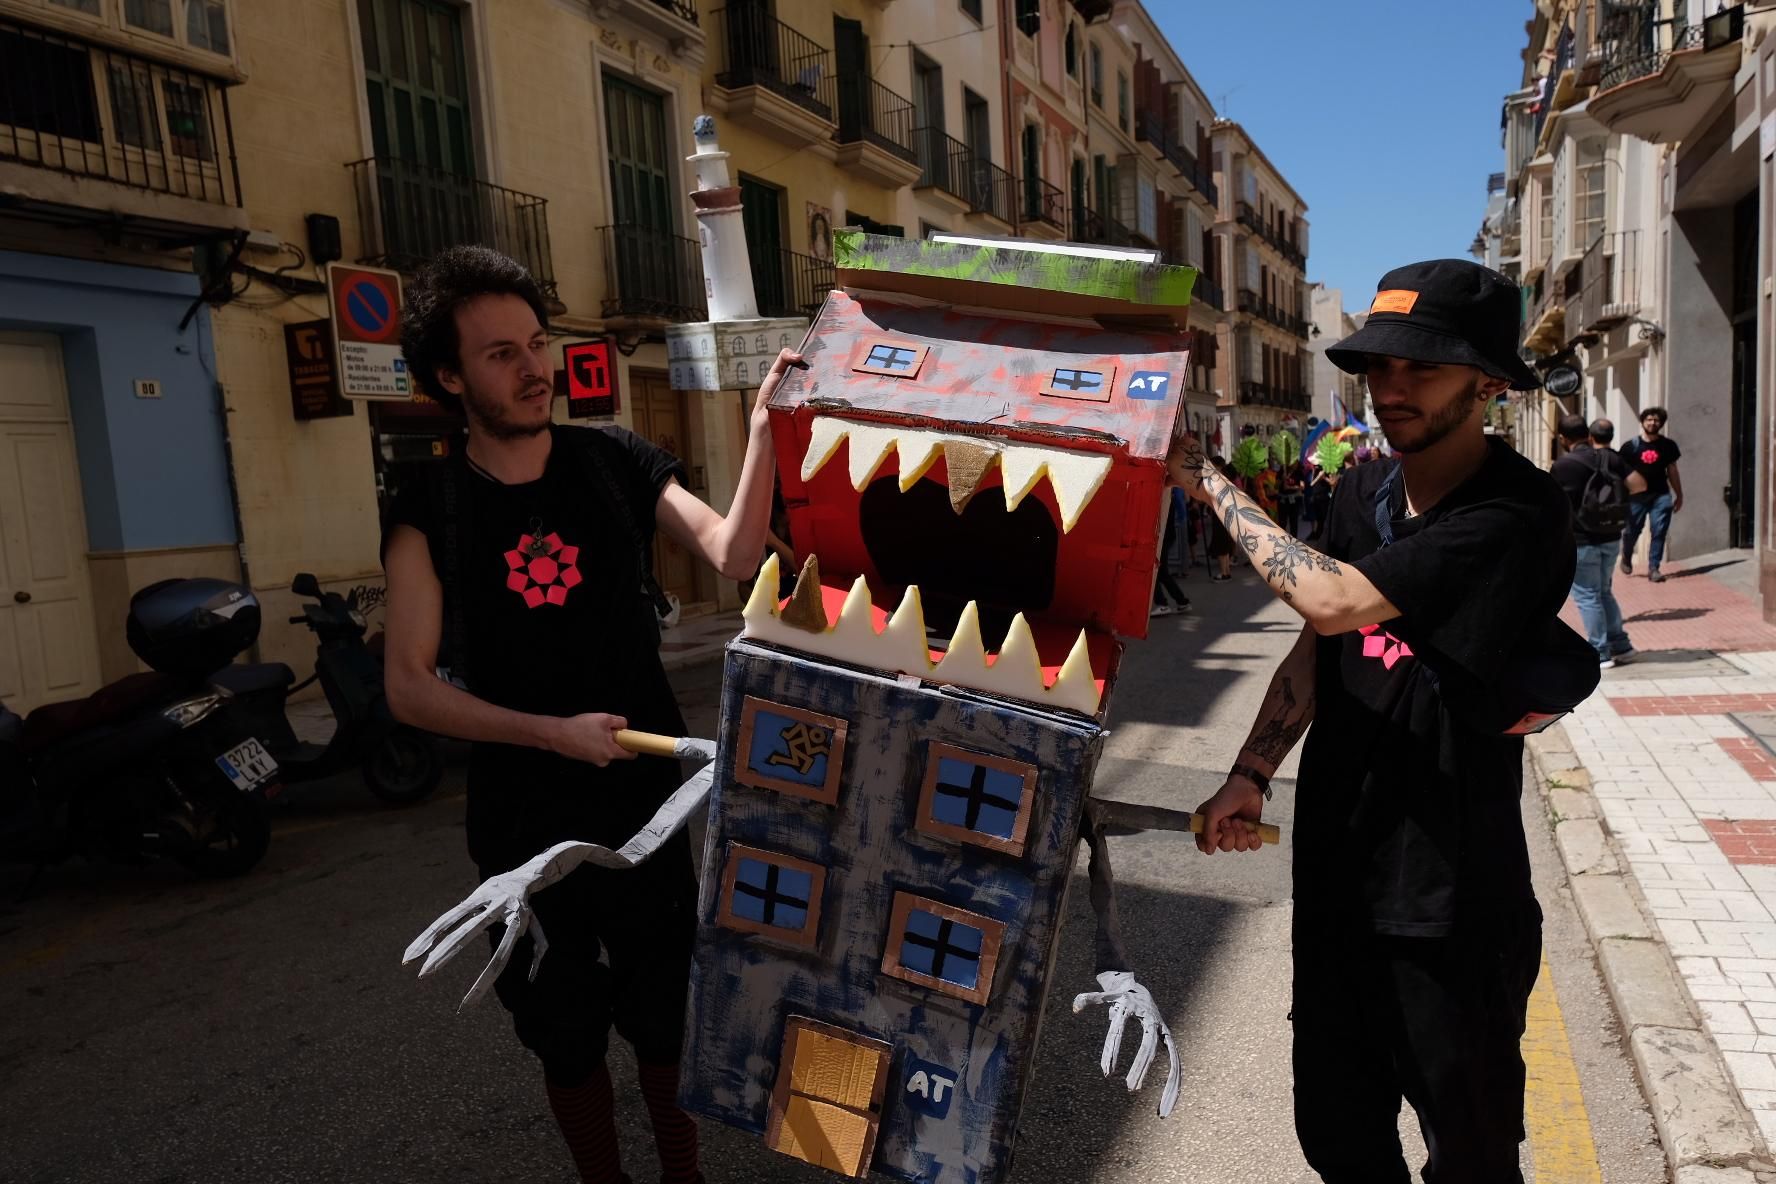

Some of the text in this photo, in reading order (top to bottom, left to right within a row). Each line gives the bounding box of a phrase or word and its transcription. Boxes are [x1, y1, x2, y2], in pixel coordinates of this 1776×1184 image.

[1129, 375, 1167, 392] AT
[228, 741, 262, 767] 3722
[906, 1070, 954, 1103] AT
